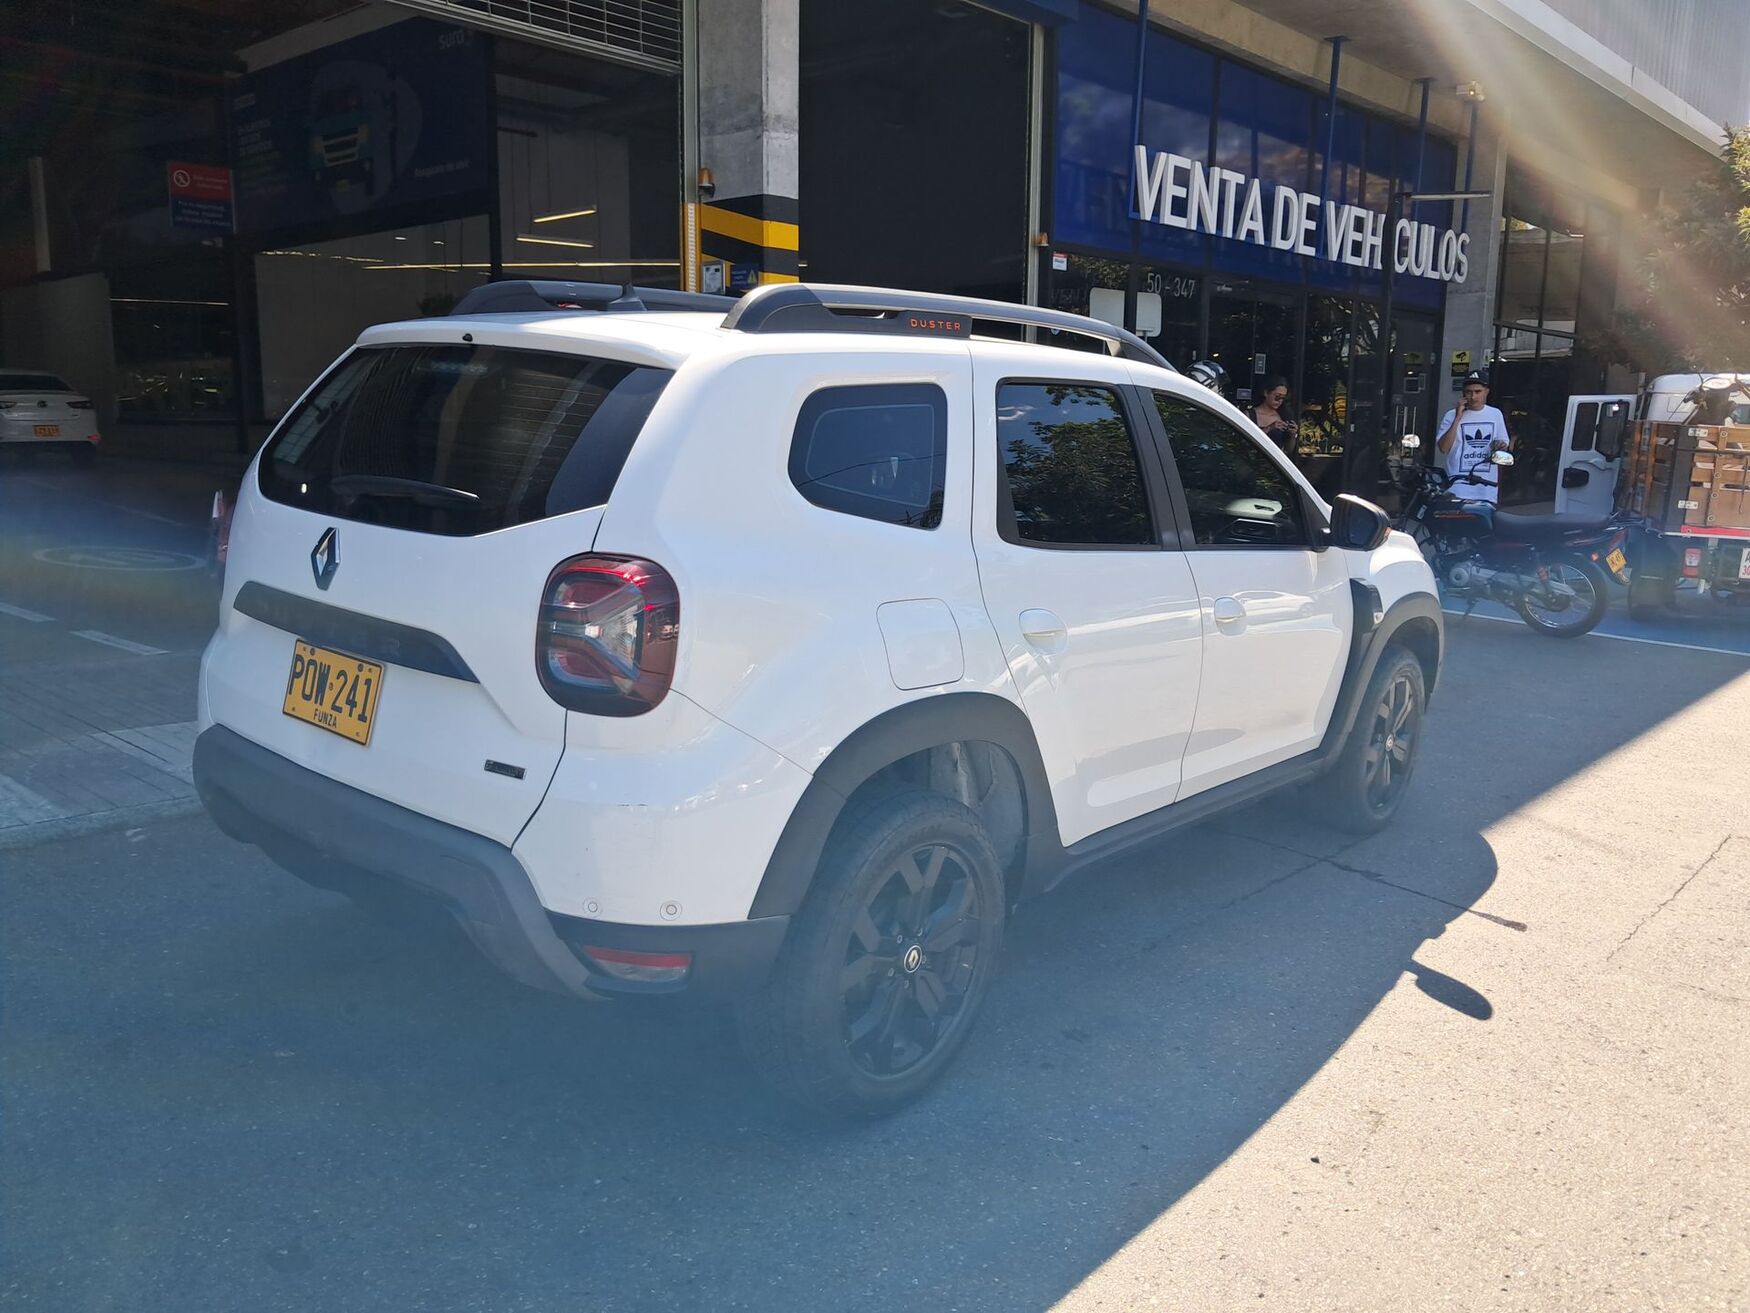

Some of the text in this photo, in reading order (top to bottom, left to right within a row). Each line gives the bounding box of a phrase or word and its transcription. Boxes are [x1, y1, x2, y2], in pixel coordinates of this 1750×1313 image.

[1135, 144, 1471, 284] VENTA DE VEHCULOS
[1146, 272, 1162, 294] 50
[1174, 277, 1196, 299] 347
[910, 318, 961, 331] DUSTER
[1463, 450, 1489, 460] adida
[313, 708, 337, 729] FUNZA
